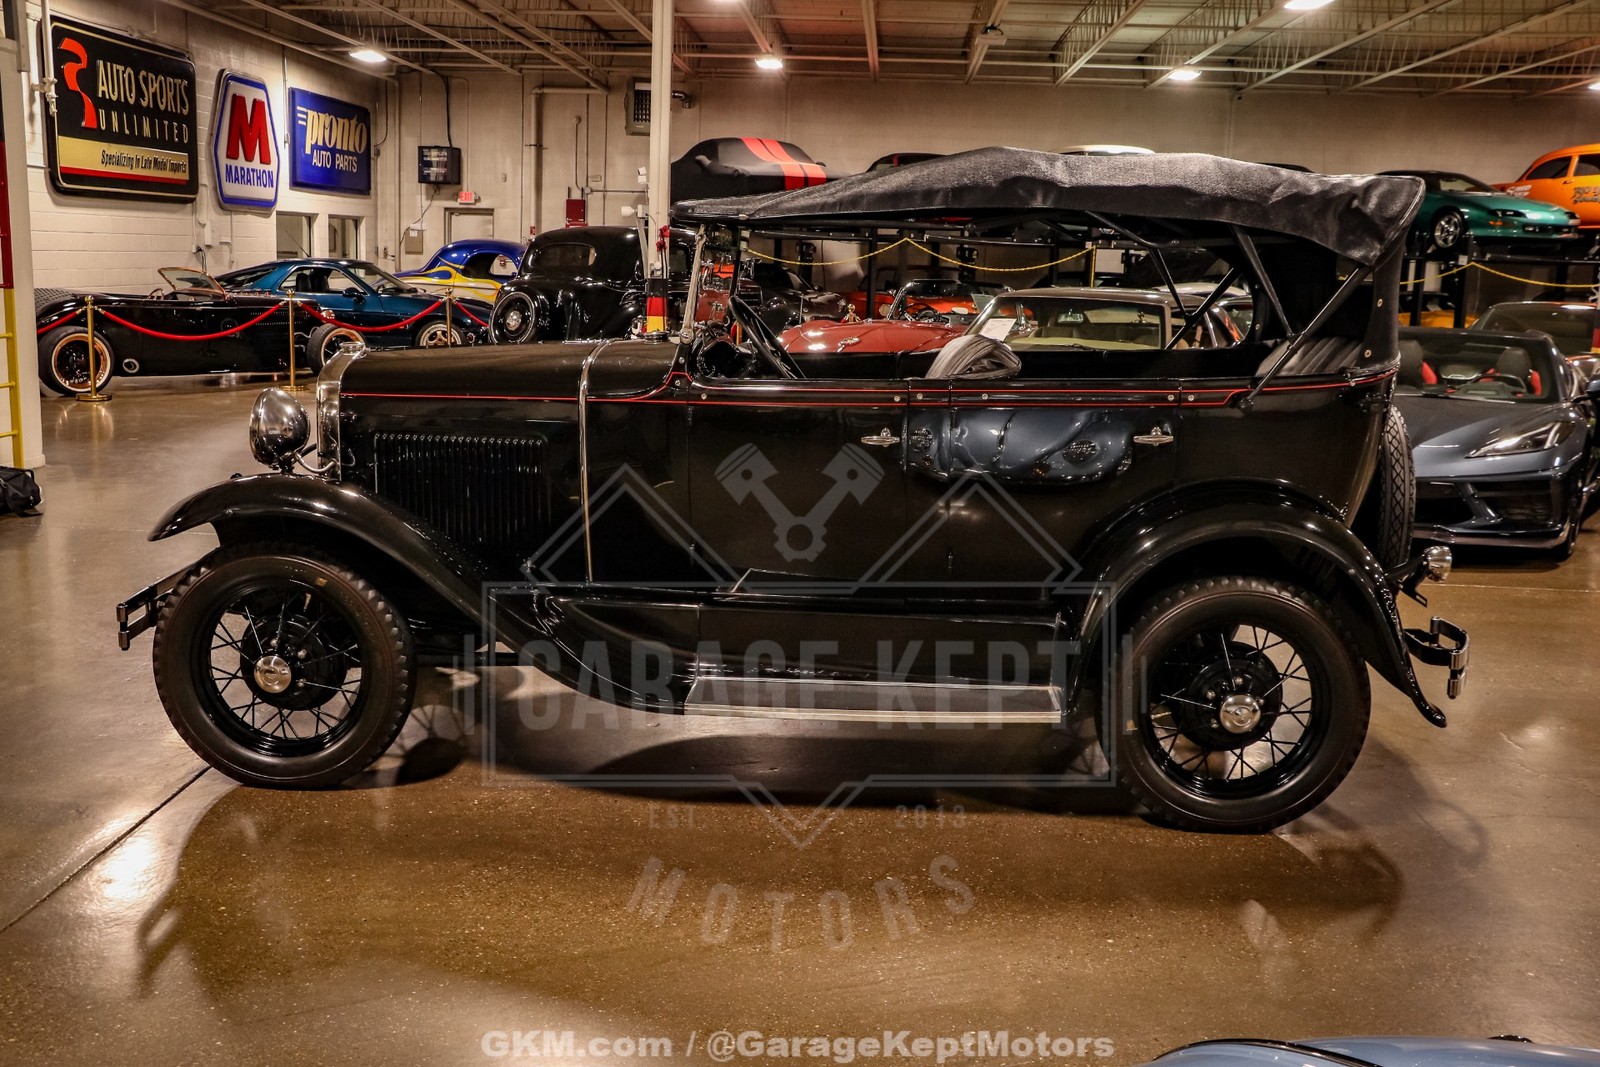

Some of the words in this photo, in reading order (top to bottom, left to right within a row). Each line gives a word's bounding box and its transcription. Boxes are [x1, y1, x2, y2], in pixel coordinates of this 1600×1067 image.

[97, 60, 136, 105] AUTO
[139, 70, 189, 116] SPORTS
[98, 108, 189, 144] UNLIMITED
[226, 93, 271, 165] M
[305, 109, 368, 154] pronto
[101, 149, 134, 170] Specializing
[312, 149, 332, 169] AUTO
[335, 153, 358, 173] PARTS
[225, 163, 274, 189] MARATHON
[459, 191, 473, 202] EXIT
